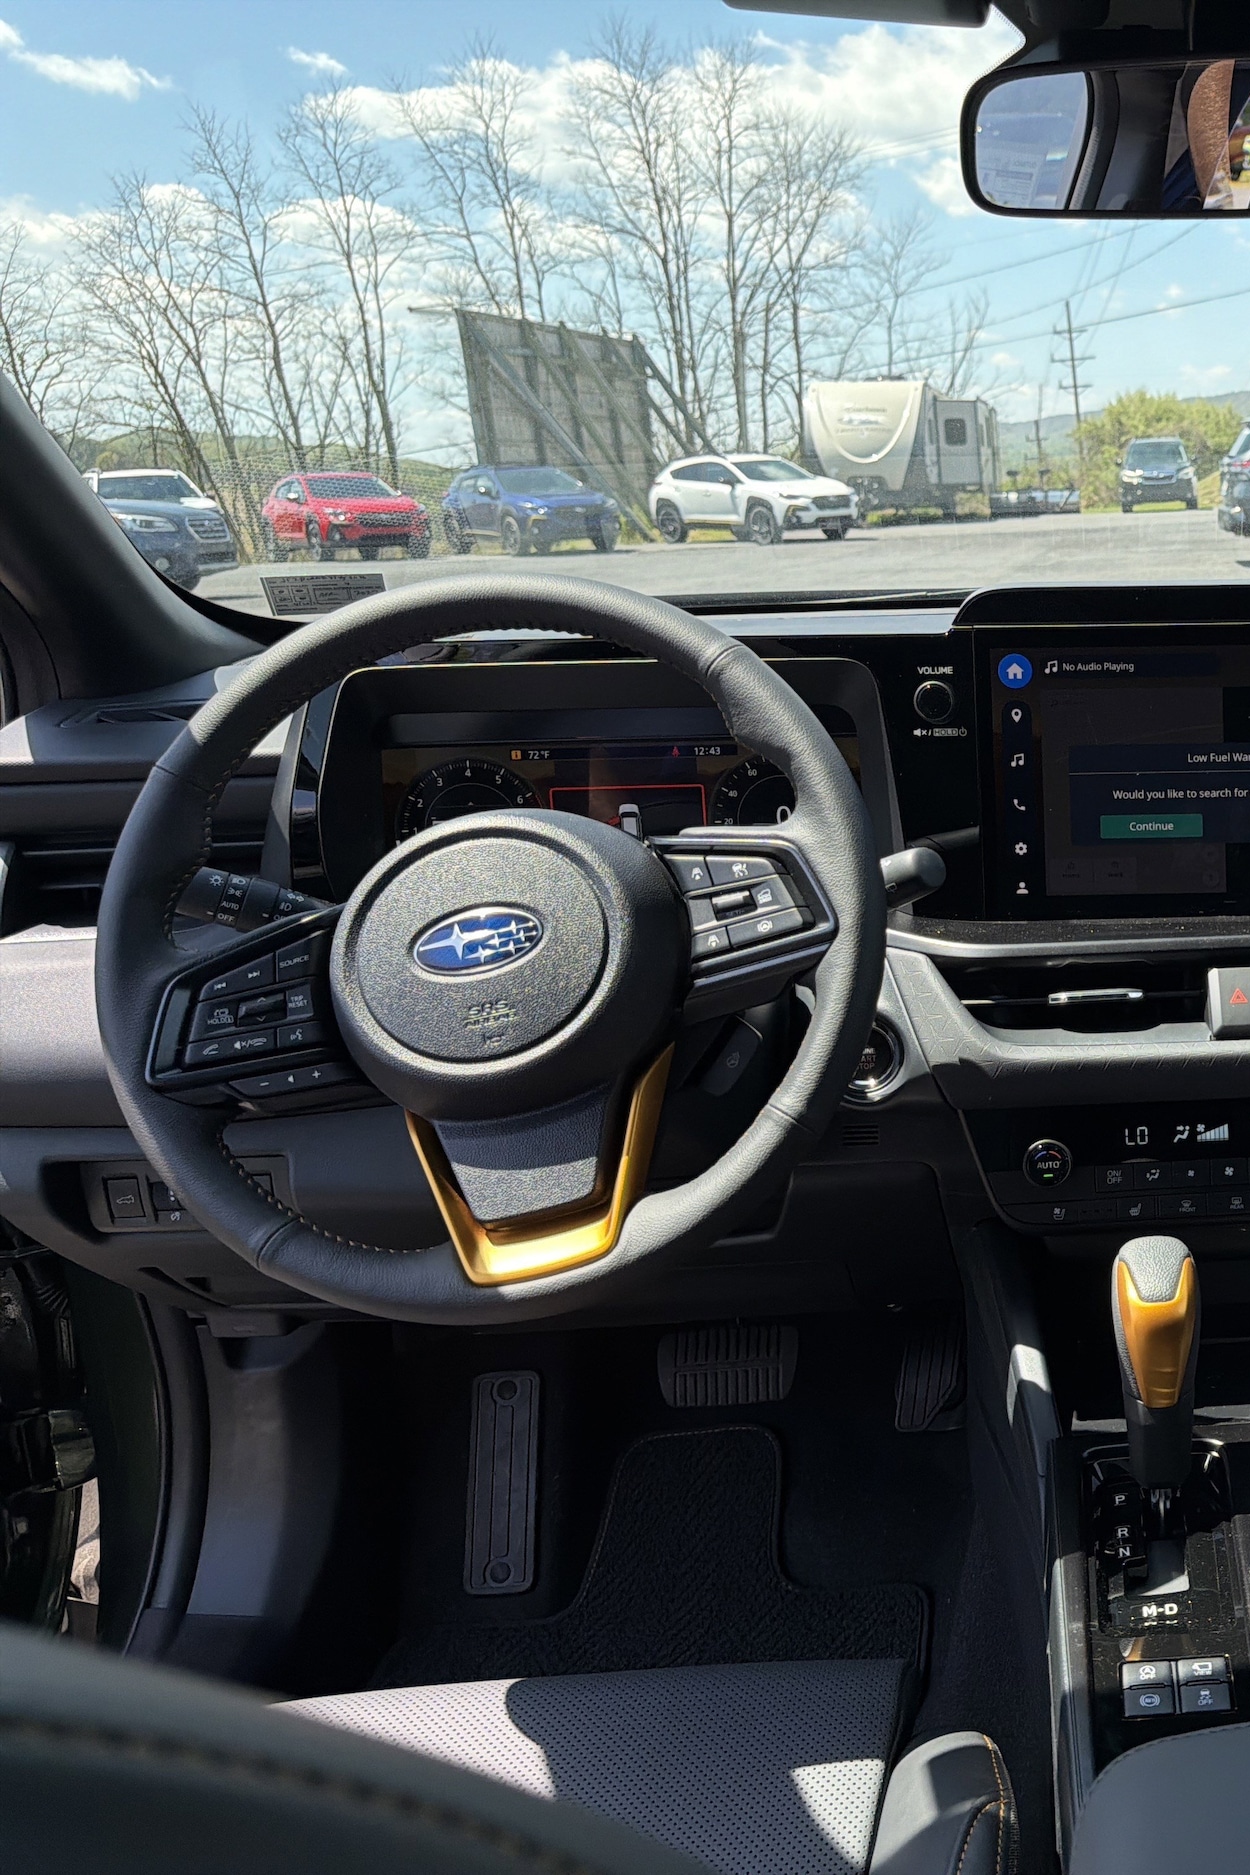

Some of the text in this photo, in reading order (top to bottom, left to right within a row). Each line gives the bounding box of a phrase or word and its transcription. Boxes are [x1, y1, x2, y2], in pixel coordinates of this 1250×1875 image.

[917, 666, 953, 674] VOLUME
[1063, 662, 1134, 672] No Audio Playing
[694, 746, 720, 755] 12:43
[1188, 754, 1207, 763] Low
[1210, 753, 1230, 762] Fuel
[465, 769, 471, 777] 4
[436, 778, 443, 786] 3
[495, 776, 501, 784] 5
[1113, 789, 1144, 800] Would
[1147, 792, 1165, 801] you
[1168, 789, 1184, 799] like
[1187, 790, 1197, 798] to
[1199, 788, 1231, 798] search
[1234, 788, 1248, 798] for
[417, 799, 423, 807] 2
[517, 795, 523, 804] 6
[1129, 822, 1174, 832] Continue
[221, 901, 239, 911] AUTO
[217, 912, 235, 922] OFF
[279, 954, 309, 968] SOURCE
[288, 1000, 308, 1008] RESET
[208, 1016, 226, 1025] HOLD
[1125, 1126, 1149, 1145] LO
[1115, 1495, 1126, 1504] P
[1117, 1528, 1129, 1538] R
[1118, 1547, 1130, 1556] N
